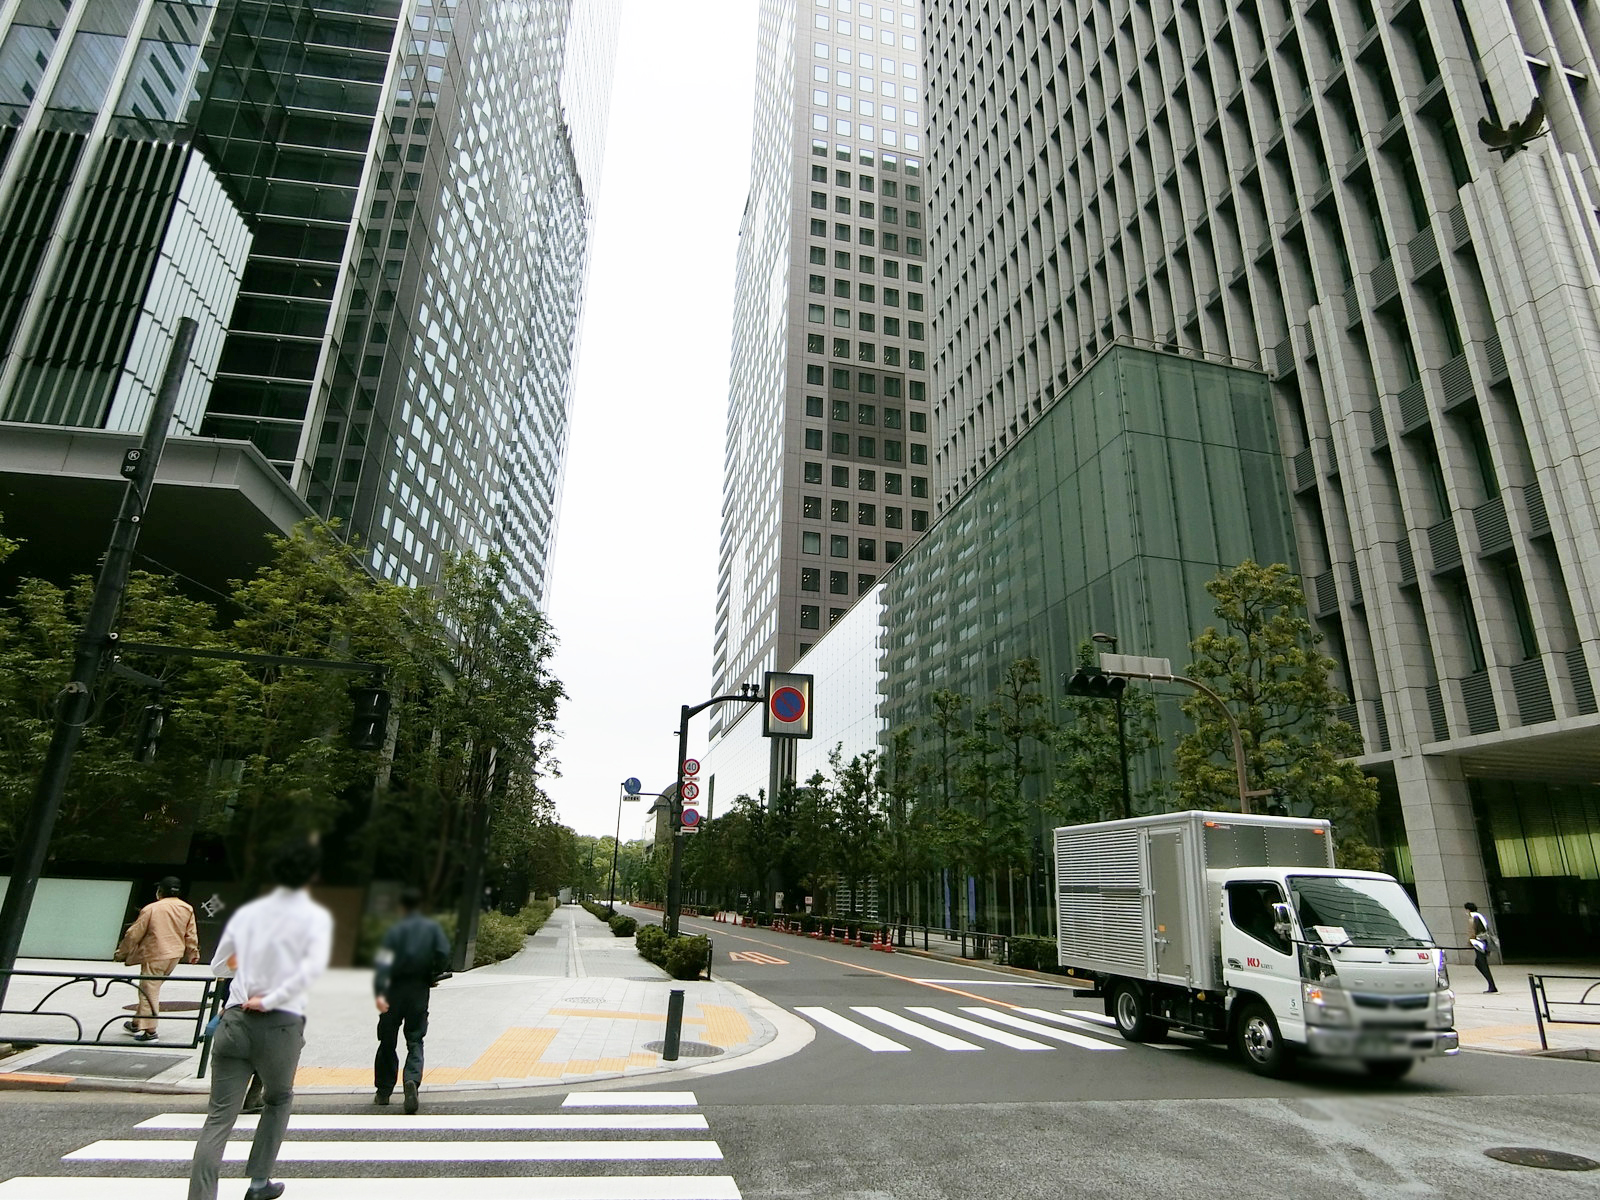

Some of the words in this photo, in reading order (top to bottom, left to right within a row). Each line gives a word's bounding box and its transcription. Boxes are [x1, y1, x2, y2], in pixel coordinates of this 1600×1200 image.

[687, 763, 696, 771] 40
[729, 952, 790, 964] 40
[1291, 999, 1295, 1007] 5
